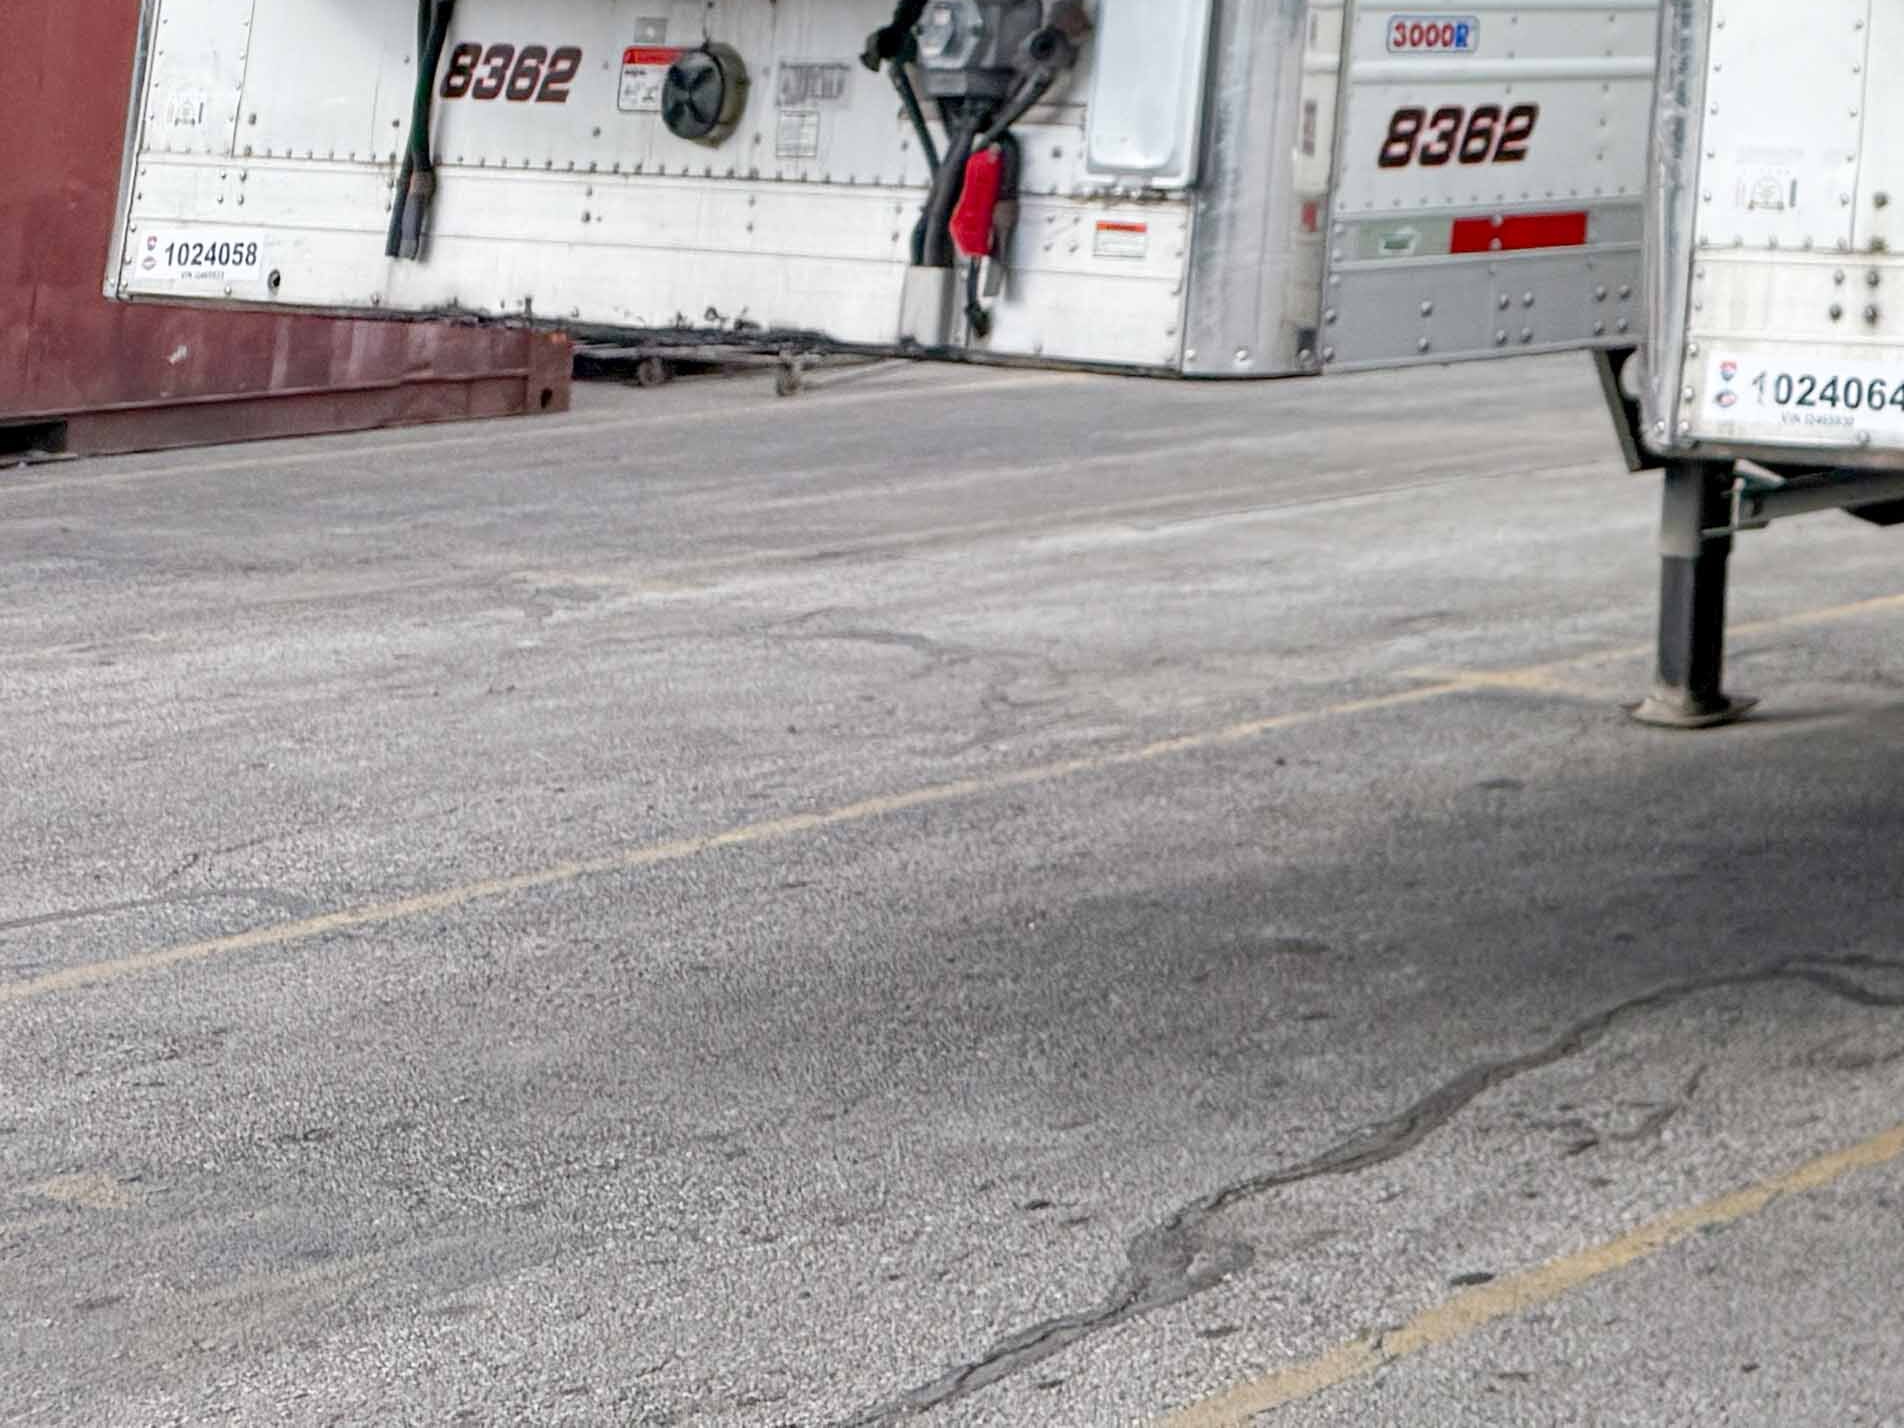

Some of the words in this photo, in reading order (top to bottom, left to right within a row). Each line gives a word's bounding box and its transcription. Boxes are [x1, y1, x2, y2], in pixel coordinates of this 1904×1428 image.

[1392, 20, 1470, 48] 3000R
[440, 42, 583, 103] 8362
[1377, 100, 1540, 169] 8362
[164, 241, 259, 267] 1024058
